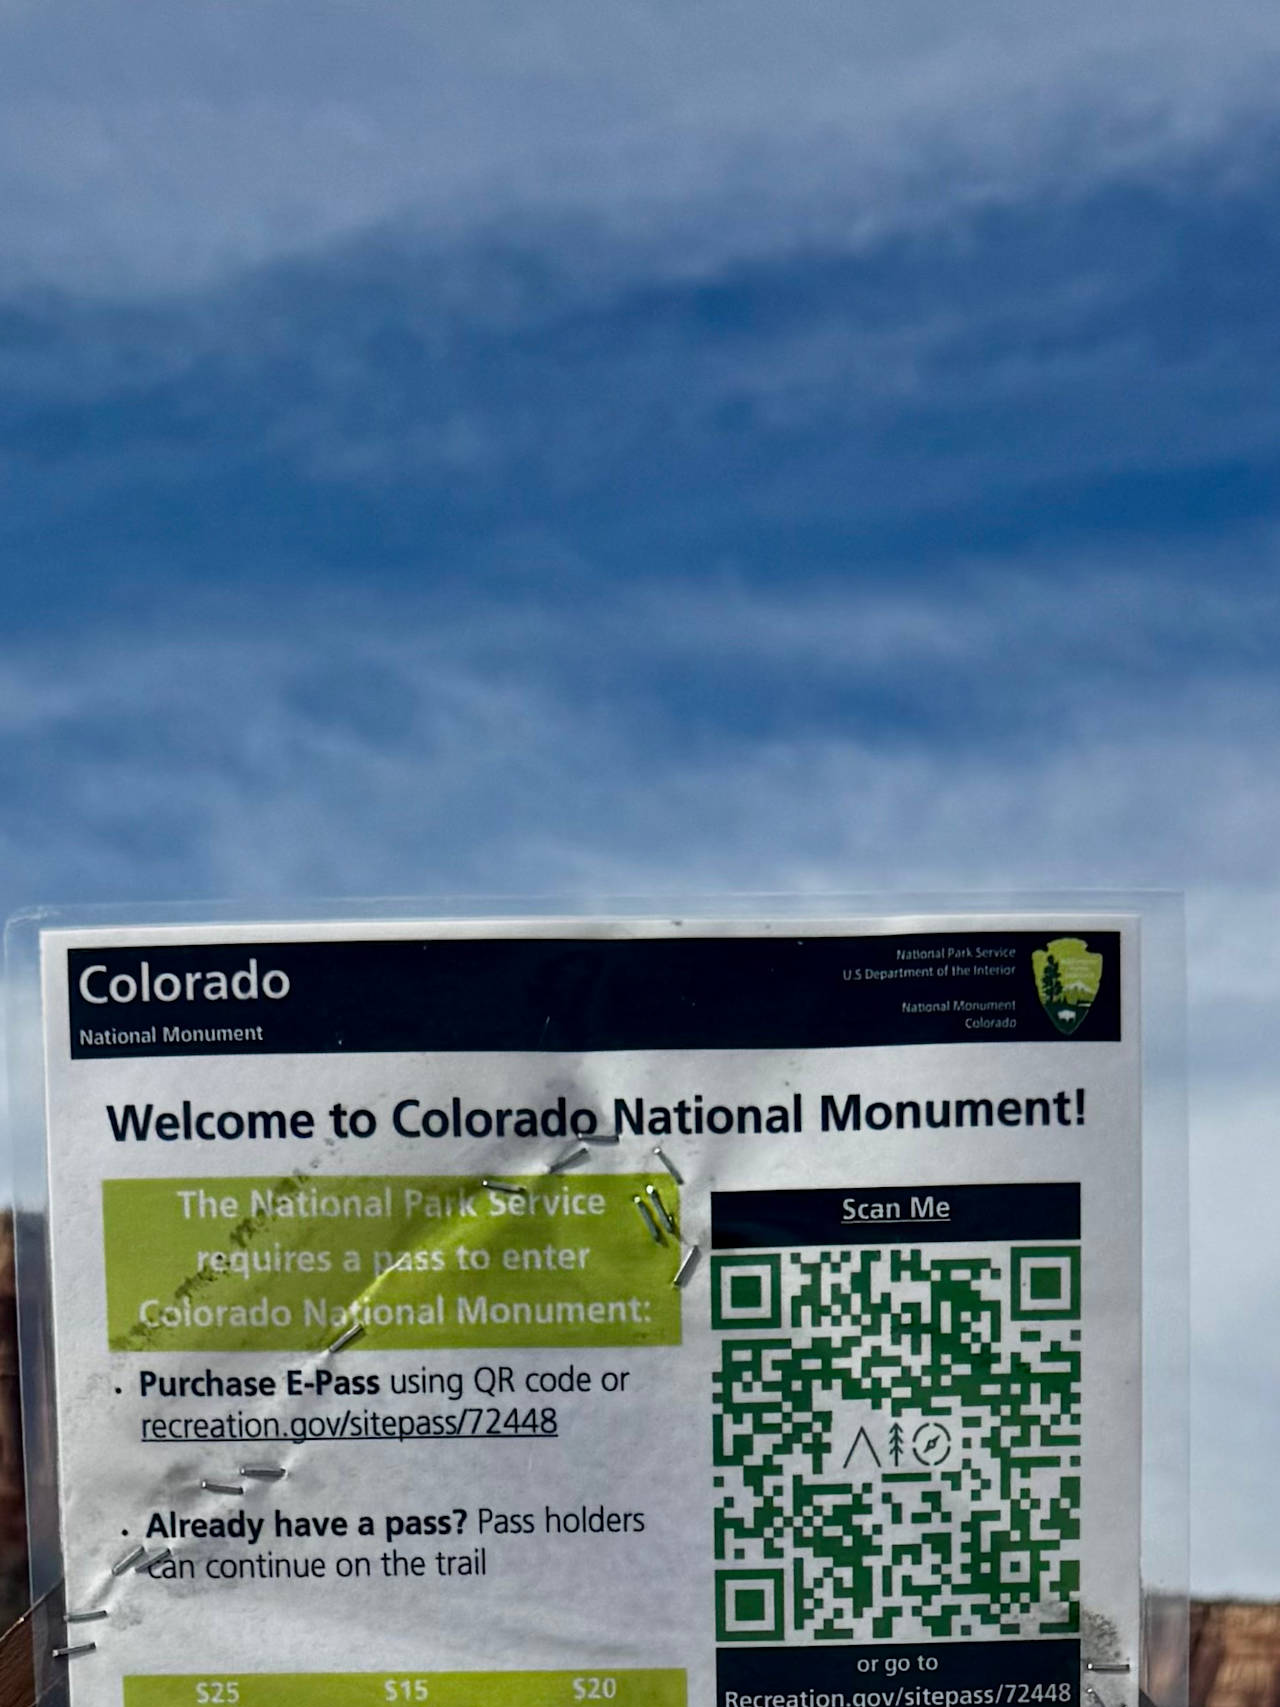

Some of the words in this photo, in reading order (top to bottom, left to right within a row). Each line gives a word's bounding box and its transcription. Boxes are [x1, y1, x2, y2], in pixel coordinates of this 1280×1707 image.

[896, 949, 946, 961] National
[948, 947, 972, 959] Park
[976, 946, 1016, 958] Service
[78, 958, 291, 1005] Colorado
[865, 966, 934, 981] Department
[937, 966, 949, 977] of
[952, 965, 970, 977] the
[973, 964, 1016, 976] Interior
[902, 1001, 950, 1013] National
[954, 999, 1016, 1012] Monument
[965, 1017, 1017, 1029] Colorado
[80, 1026, 157, 1047] National
[163, 1025, 264, 1045] Monument
[106, 1100, 315, 1142] Welcome
[329, 1103, 377, 1140] to
[392, 1096, 597, 1140] Colorado
[614, 1094, 803, 1136] National
[820, 1088, 1087, 1132] Monument!
[177, 1189, 238, 1220] The
[251, 1188, 392, 1218] National
[406, 1186, 477, 1217] Park
[489, 1185, 607, 1216] Service
[842, 1198, 901, 1221] Scan
[910, 1196, 951, 1219] Me
[197, 1247, 334, 1279] requires
[342, 1250, 361, 1273] a
[374, 1250, 445, 1278] pass
[456, 1246, 490, 1270] to
[503, 1245, 590, 1270] enter
[139, 1299, 292, 1330] Colorado
[305, 1297, 445, 1328] National
[457, 1296, 652, 1325] Monument:
[140, 1370, 276, 1399] Purchase
[287, 1369, 380, 1397] E-Pass
[391, 1367, 463, 1401] using
[474, 1366, 515, 1397] QR
[526, 1364, 592, 1394] code
[601, 1369, 630, 1393] or
[141, 1408, 559, 1442] recreation.gov/sitepass/72448
[146, 1510, 264, 1544] Already
[275, 1509, 348, 1538] have
[358, 1515, 375, 1536] a
[386, 1508, 468, 1543] pass?
[478, 1508, 535, 1534] Pass
[545, 1505, 646, 1534] holders
[206, 1550, 326, 1579] continue
[336, 1554, 371, 1577] on
[381, 1548, 426, 1576] the
[435, 1547, 487, 1576] trail
[857, 1656, 880, 1673] or
[884, 1656, 911, 1678] go
[918, 1653, 939, 1672] to
[195, 1680, 241, 1705] $25
[385, 1678, 429, 1703] $15
[573, 1676, 617, 1701] $20
